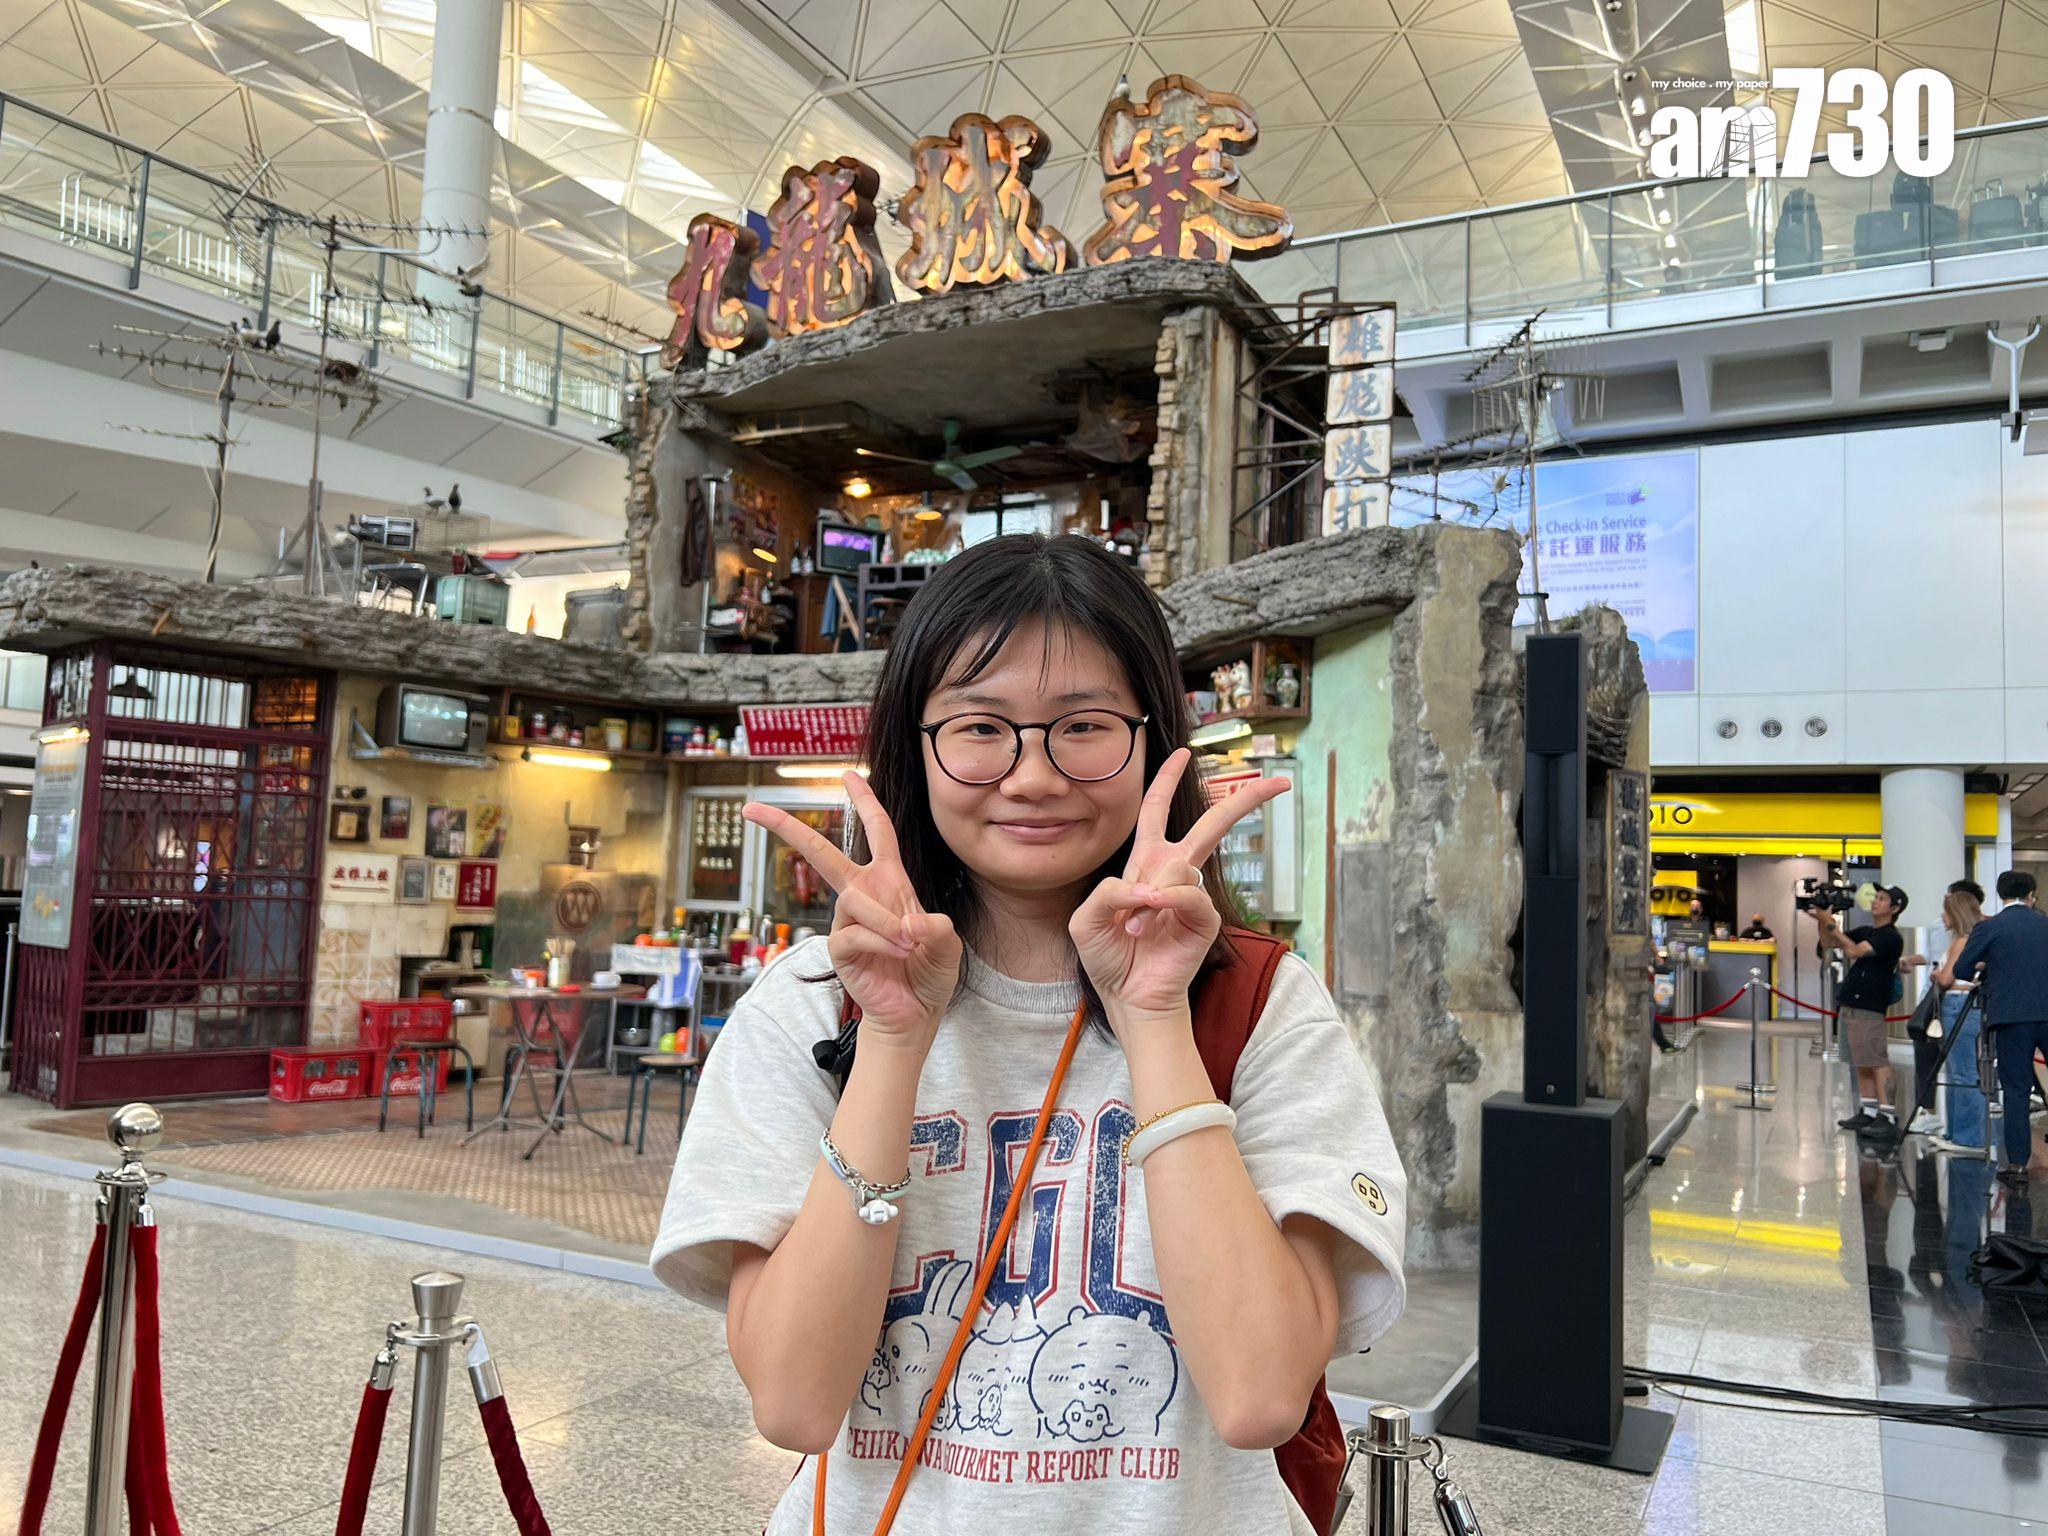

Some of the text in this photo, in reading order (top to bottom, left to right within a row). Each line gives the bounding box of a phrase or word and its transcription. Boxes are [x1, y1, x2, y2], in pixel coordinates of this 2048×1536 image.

[660, 74, 1294, 370] 九龍城寨
[1601, 512, 1647, 532] Service
[1025, 1446, 1114, 1484] REPORT
[1120, 1446, 1181, 1480] CLUB
